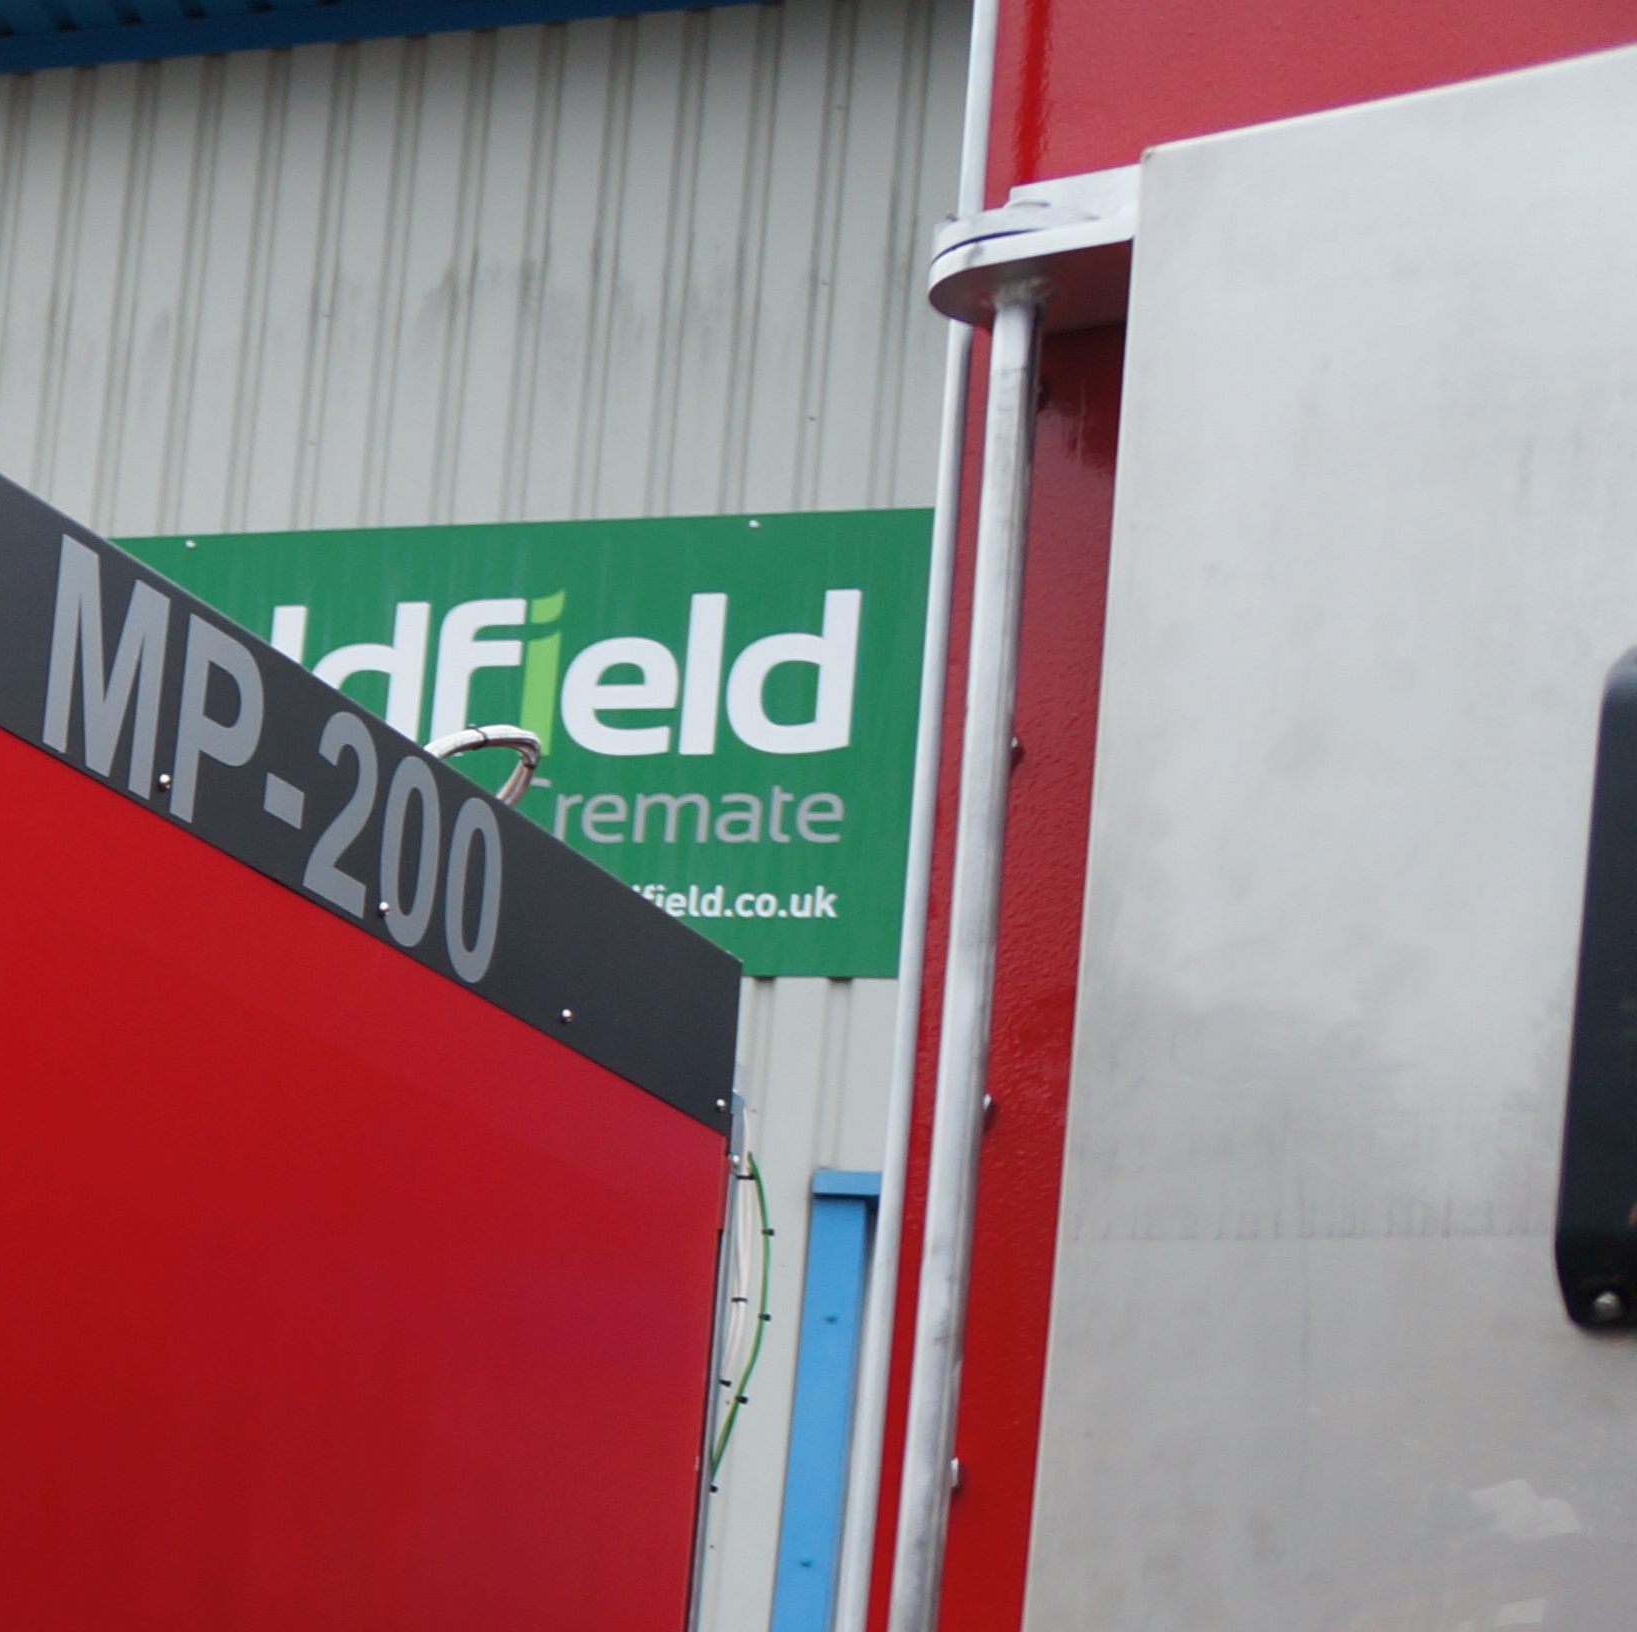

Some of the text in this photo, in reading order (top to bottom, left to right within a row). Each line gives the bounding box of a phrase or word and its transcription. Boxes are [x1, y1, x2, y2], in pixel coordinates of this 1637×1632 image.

[42, 533, 502, 983] MP-200
[529, 776, 846, 844] remate
[631, 884, 839, 918] field.co.uk
